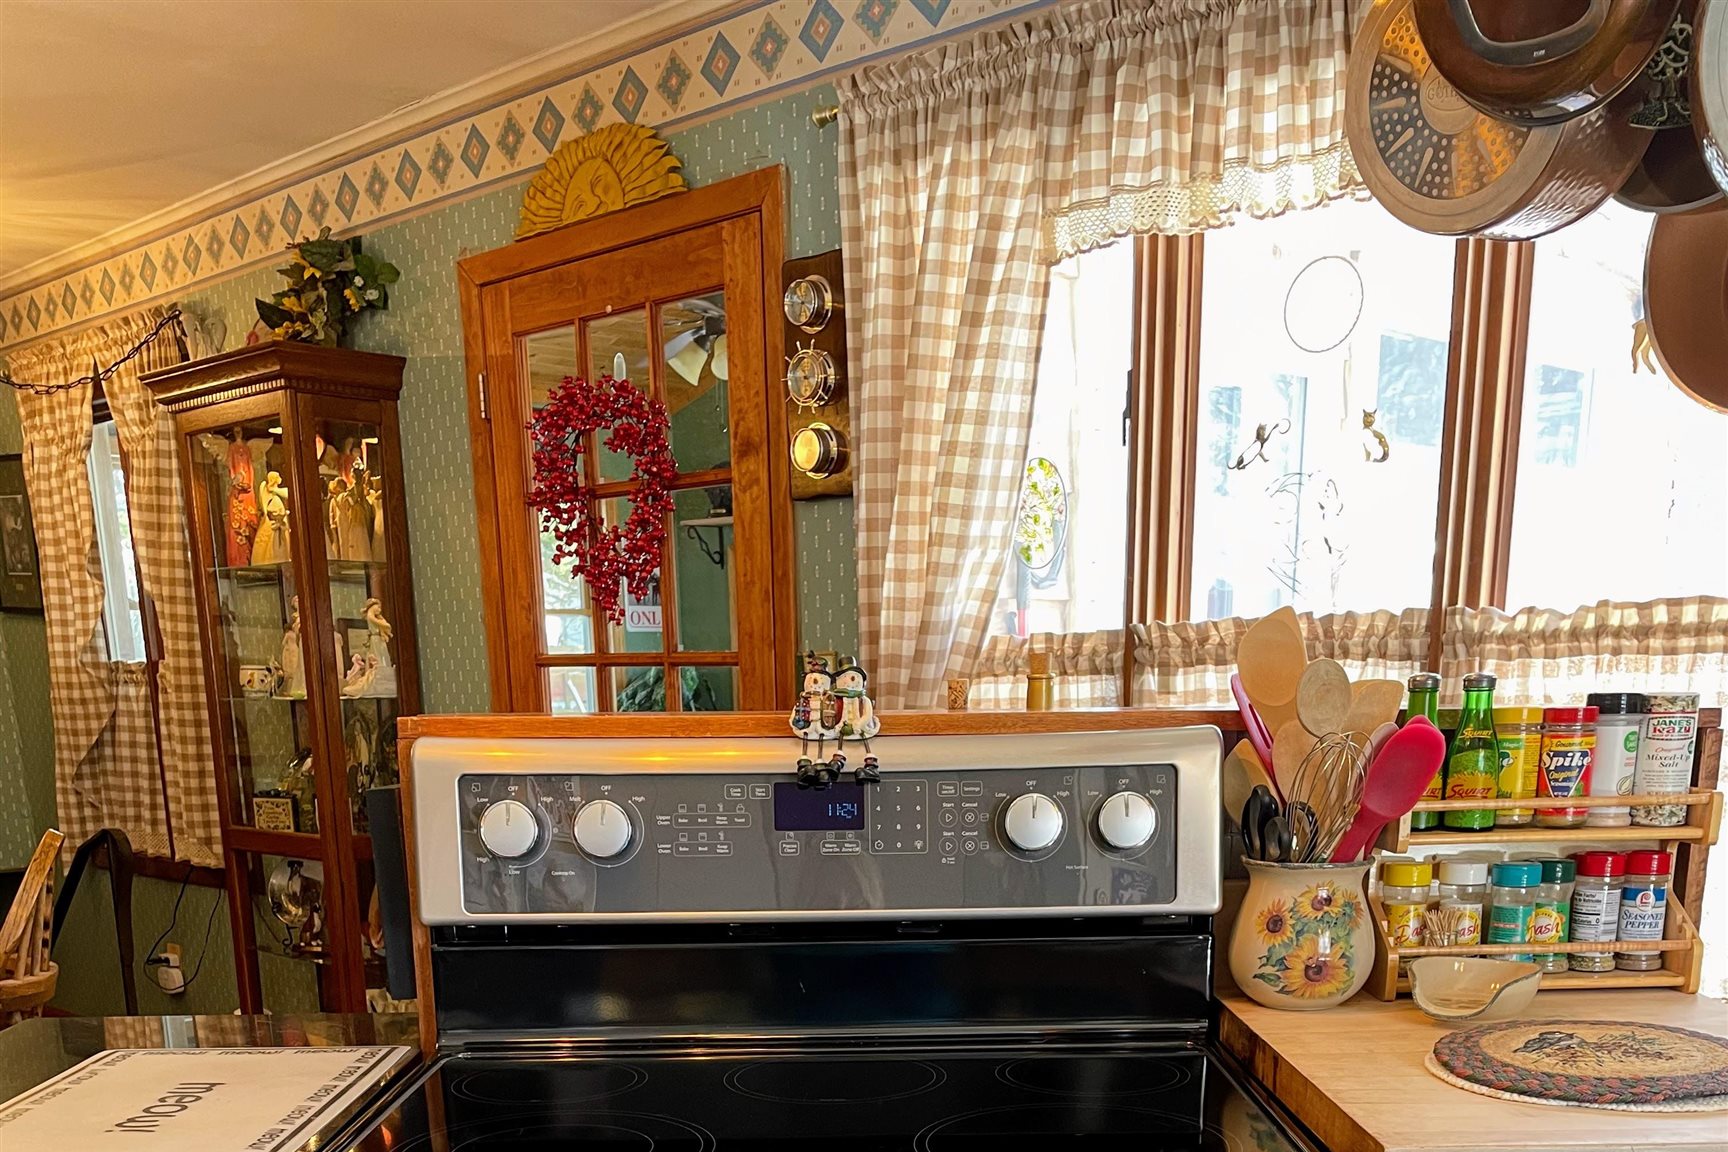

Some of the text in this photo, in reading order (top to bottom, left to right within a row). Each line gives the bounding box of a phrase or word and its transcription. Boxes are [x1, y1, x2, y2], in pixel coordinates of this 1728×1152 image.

[630, 610, 661, 625] ONL
[1459, 727, 1493, 739] SQUIRT
[1541, 750, 1592, 770] Spike
[1658, 761, 1680, 769] Salt
[1446, 784, 1493, 799] SQUIRT
[828, 803, 857, 816] 11:24
[1459, 918, 1480, 938] ash
[1624, 920, 1660, 929] PEPPER
[1394, 923, 1427, 946] Das
[104, 1082, 227, 1133] meow!
